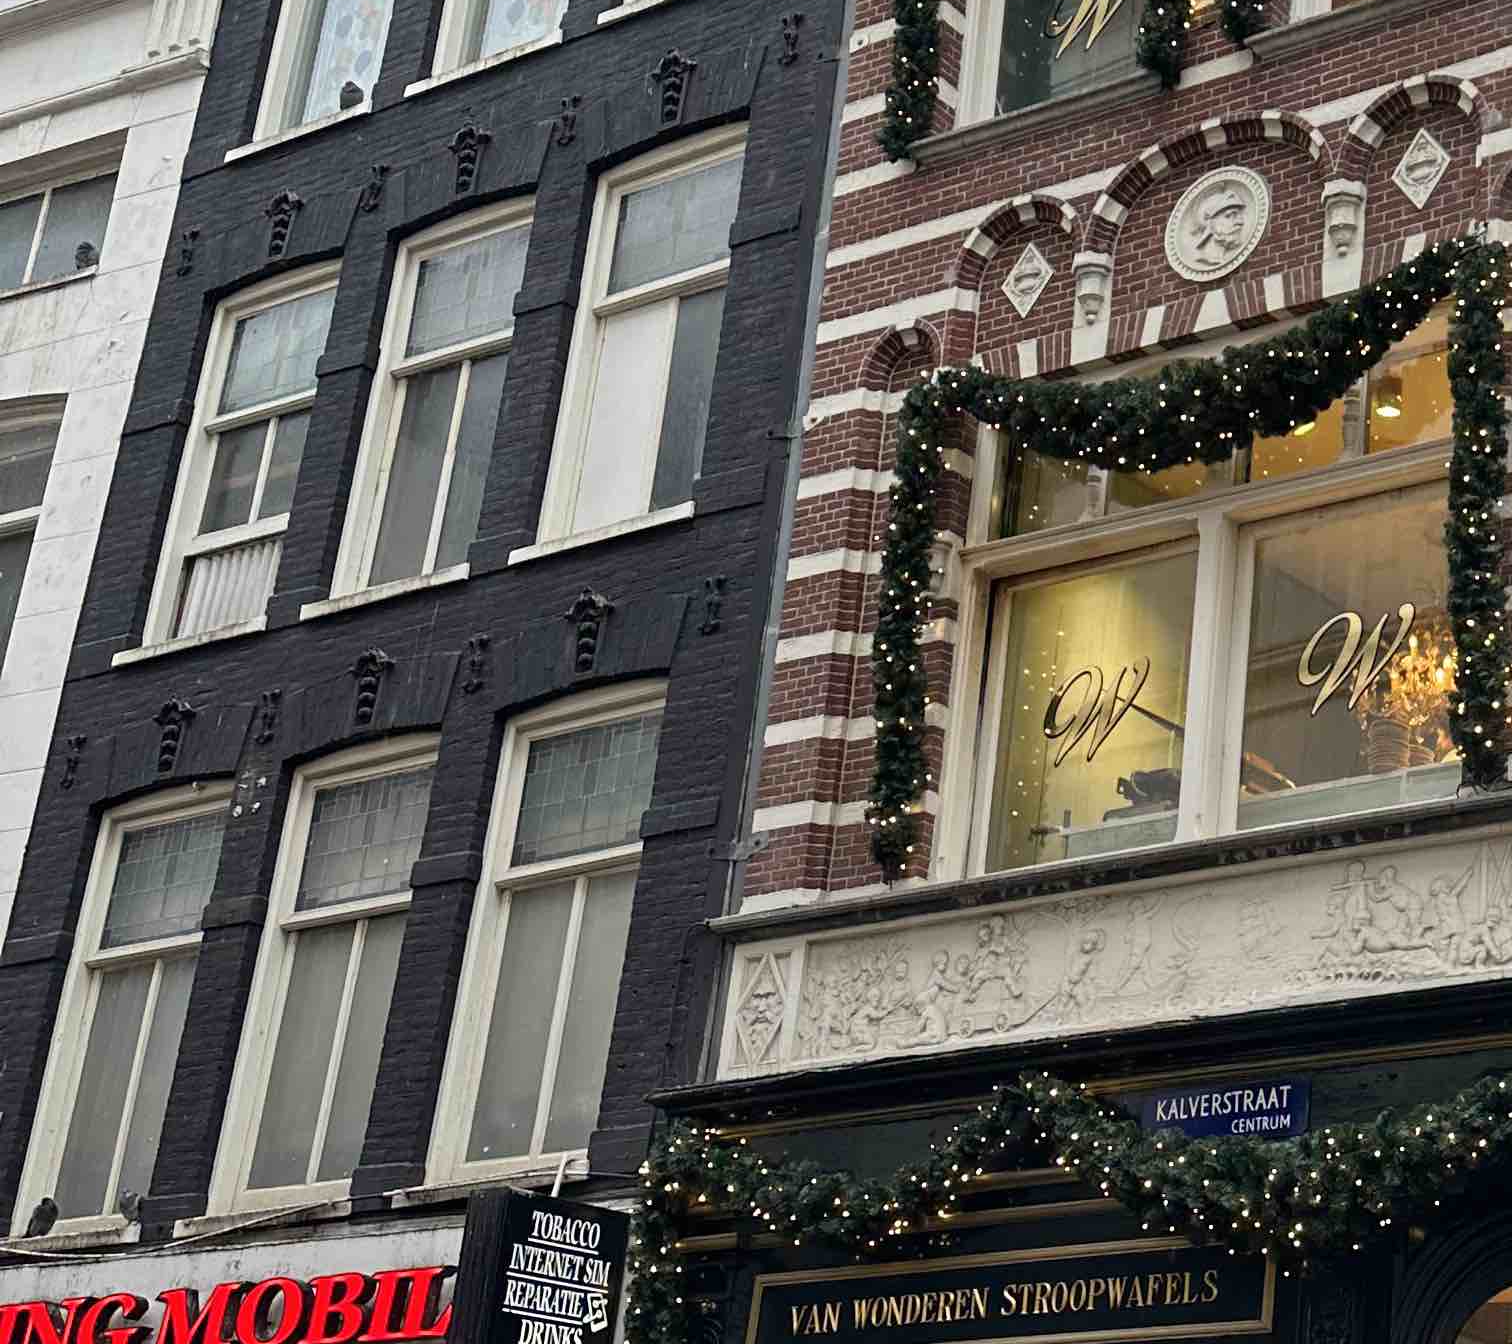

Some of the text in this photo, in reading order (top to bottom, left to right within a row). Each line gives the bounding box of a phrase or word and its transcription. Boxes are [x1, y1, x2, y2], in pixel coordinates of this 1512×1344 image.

[1298, 603, 1416, 716] W
[1044, 656, 1150, 768] W
[1156, 1085, 1292, 1121] KALVERSTRAAT
[1231, 1113, 1291, 1134] CENTRUM
[531, 1210, 601, 1249] TOBACCO
[509, 1243, 611, 1287] INTERNET SIM
[503, 1279, 585, 1318] REPARATIE
[790, 1269, 1219, 1337] VAN WONDEREN STROOPWAFELS
